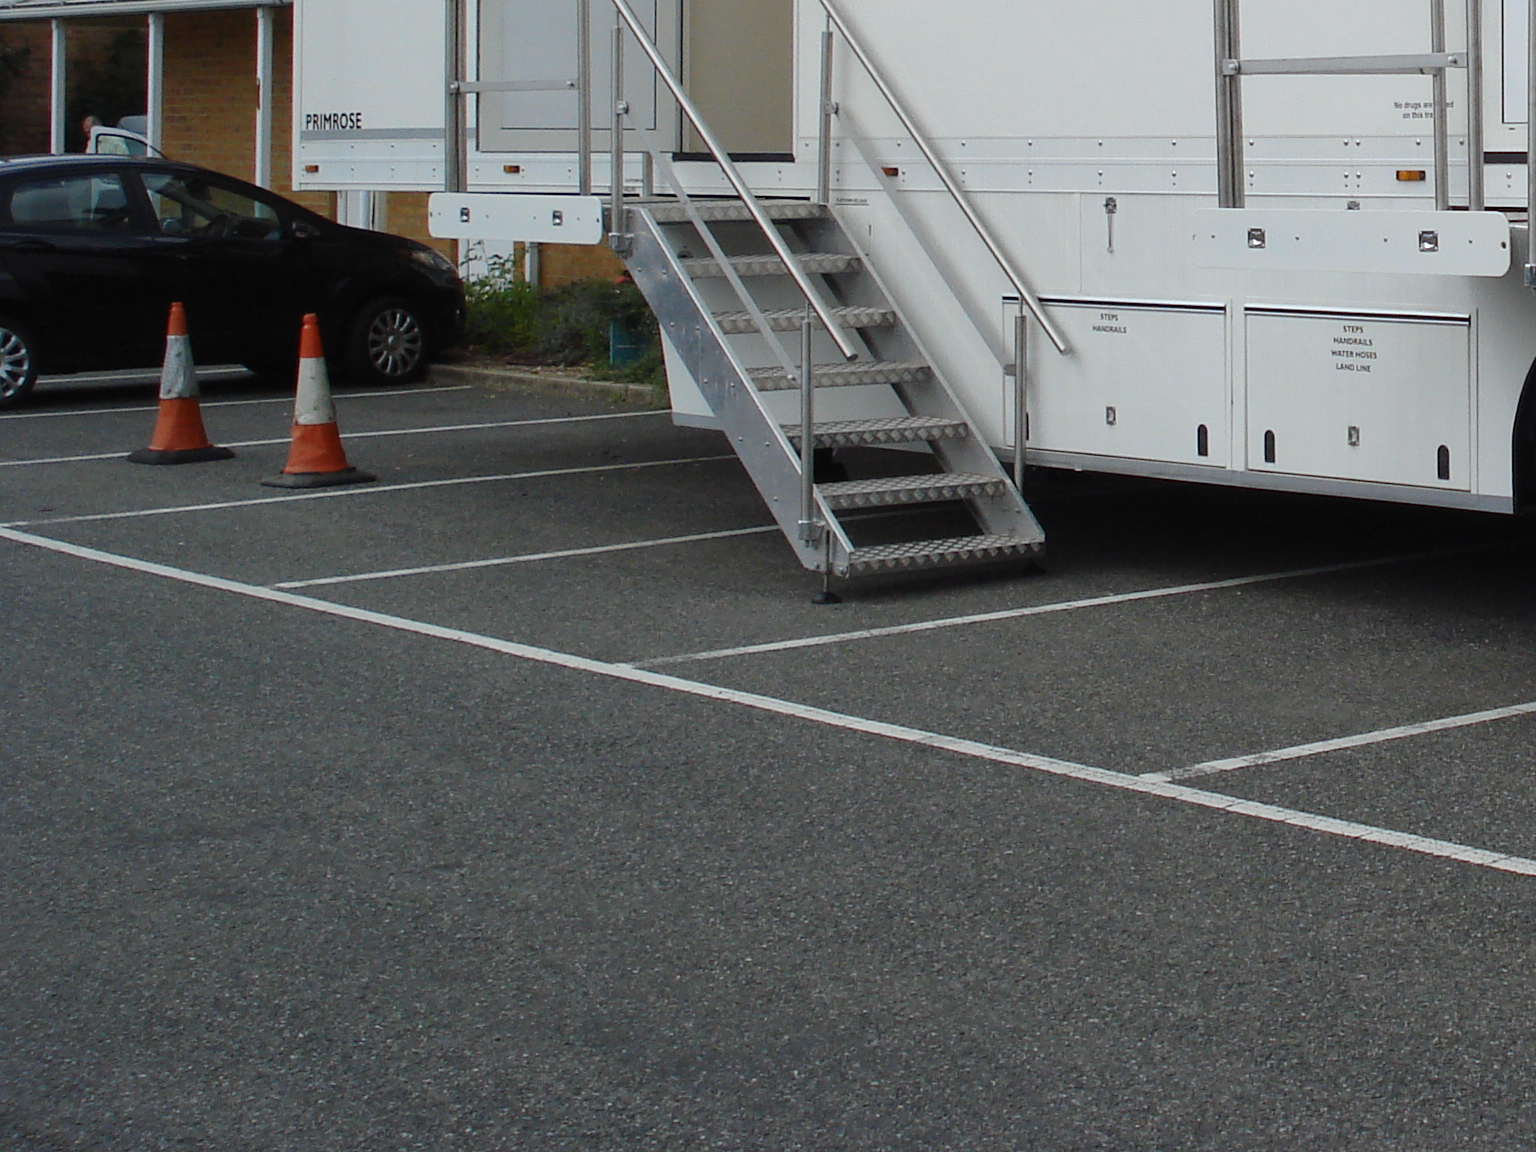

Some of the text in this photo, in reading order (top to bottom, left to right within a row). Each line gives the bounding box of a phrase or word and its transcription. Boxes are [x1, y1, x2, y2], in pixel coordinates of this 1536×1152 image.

[306, 112, 362, 130] PRIMROSE
[1100, 313, 1118, 321] STEPS
[1092, 325, 1126, 333] HANDRAILS
[1343, 325, 1363, 333] STEPS
[1333, 337, 1372, 346] HANDRAILS
[1355, 351, 1377, 359] HOSES
